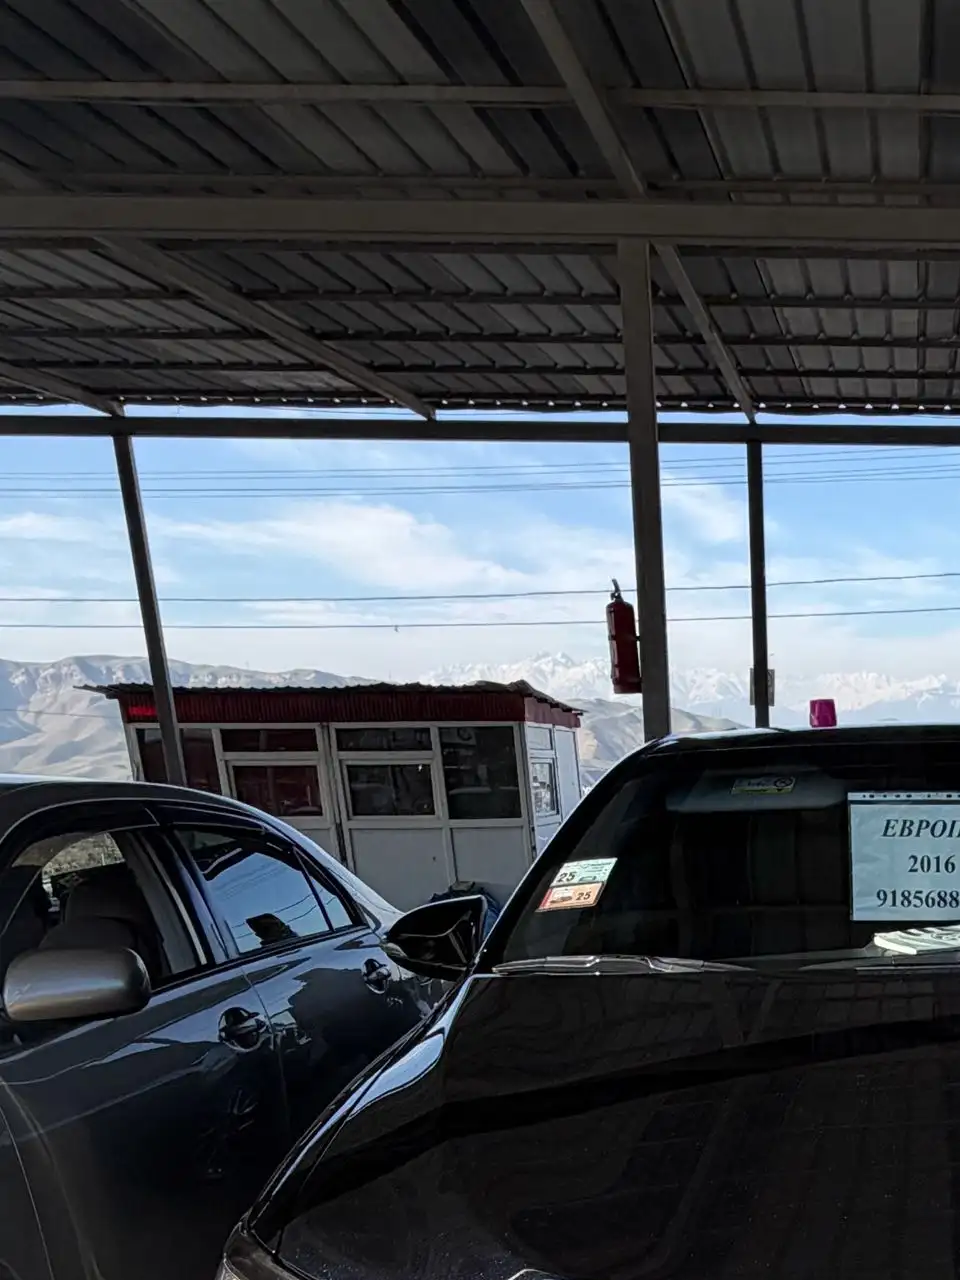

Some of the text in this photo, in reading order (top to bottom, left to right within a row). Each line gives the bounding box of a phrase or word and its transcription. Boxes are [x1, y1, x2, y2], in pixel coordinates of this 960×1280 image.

[907, 854, 956, 873] 2016
[557, 872, 577, 882] 25
[576, 891, 591, 900] 25
